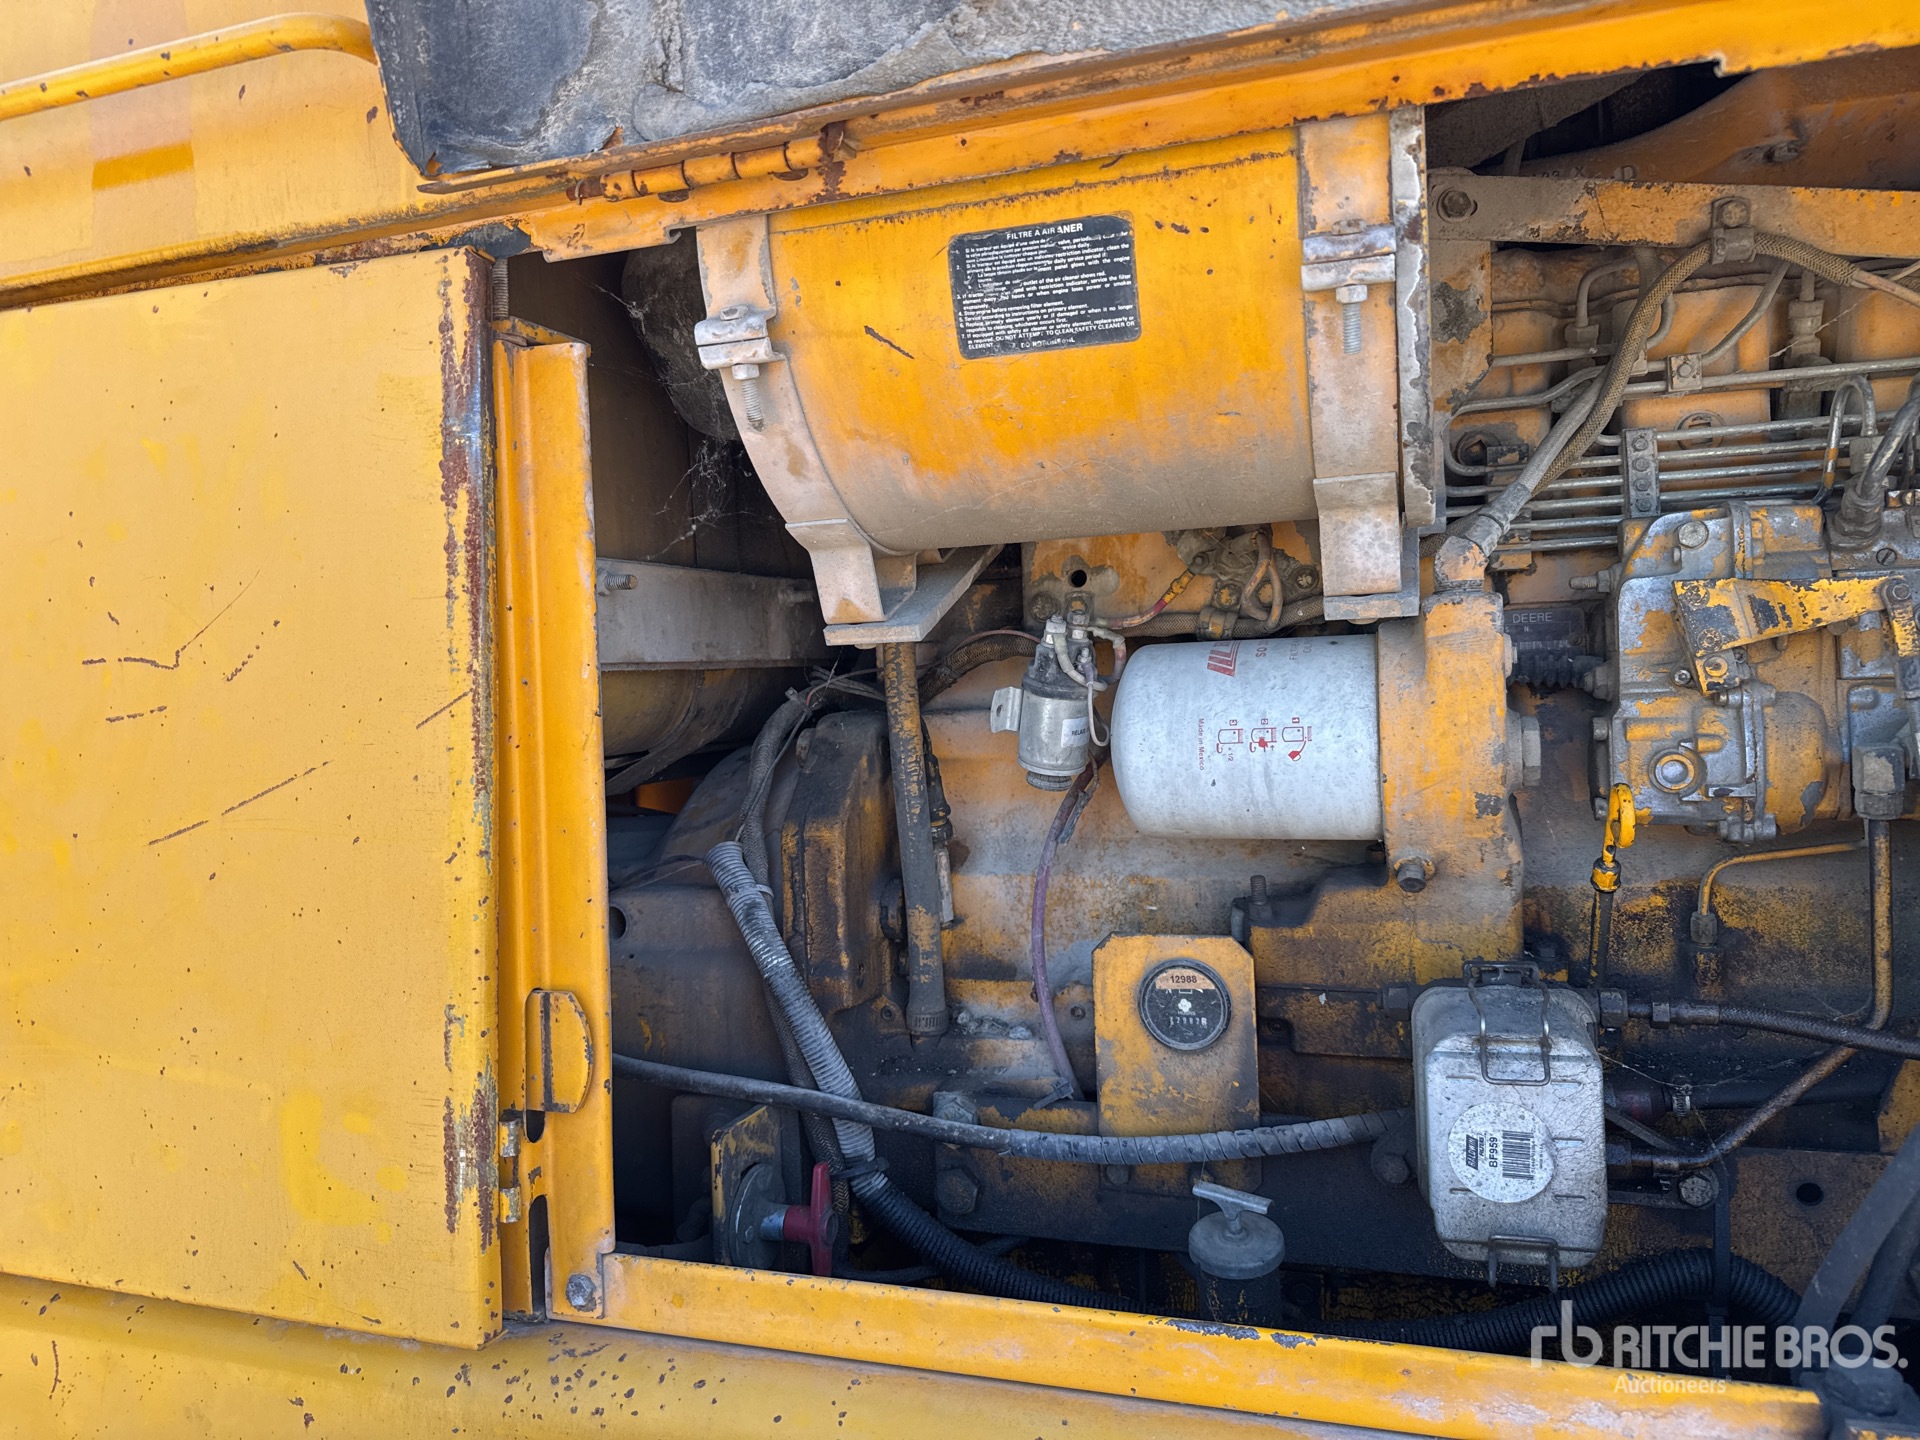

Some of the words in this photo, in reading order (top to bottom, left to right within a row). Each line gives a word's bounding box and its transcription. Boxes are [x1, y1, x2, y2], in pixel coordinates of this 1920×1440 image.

[1007, 231, 1032, 240] FILTRE
[1042, 227, 1055, 235] AIR
[1098, 322, 1125, 330] CLEANER
[1513, 612, 1552, 623] DEERE
[1170, 975, 1197, 984] 12988
[1467, 1138, 1476, 1167] BALDWIN
[1489, 1137, 1498, 1168] BF959
